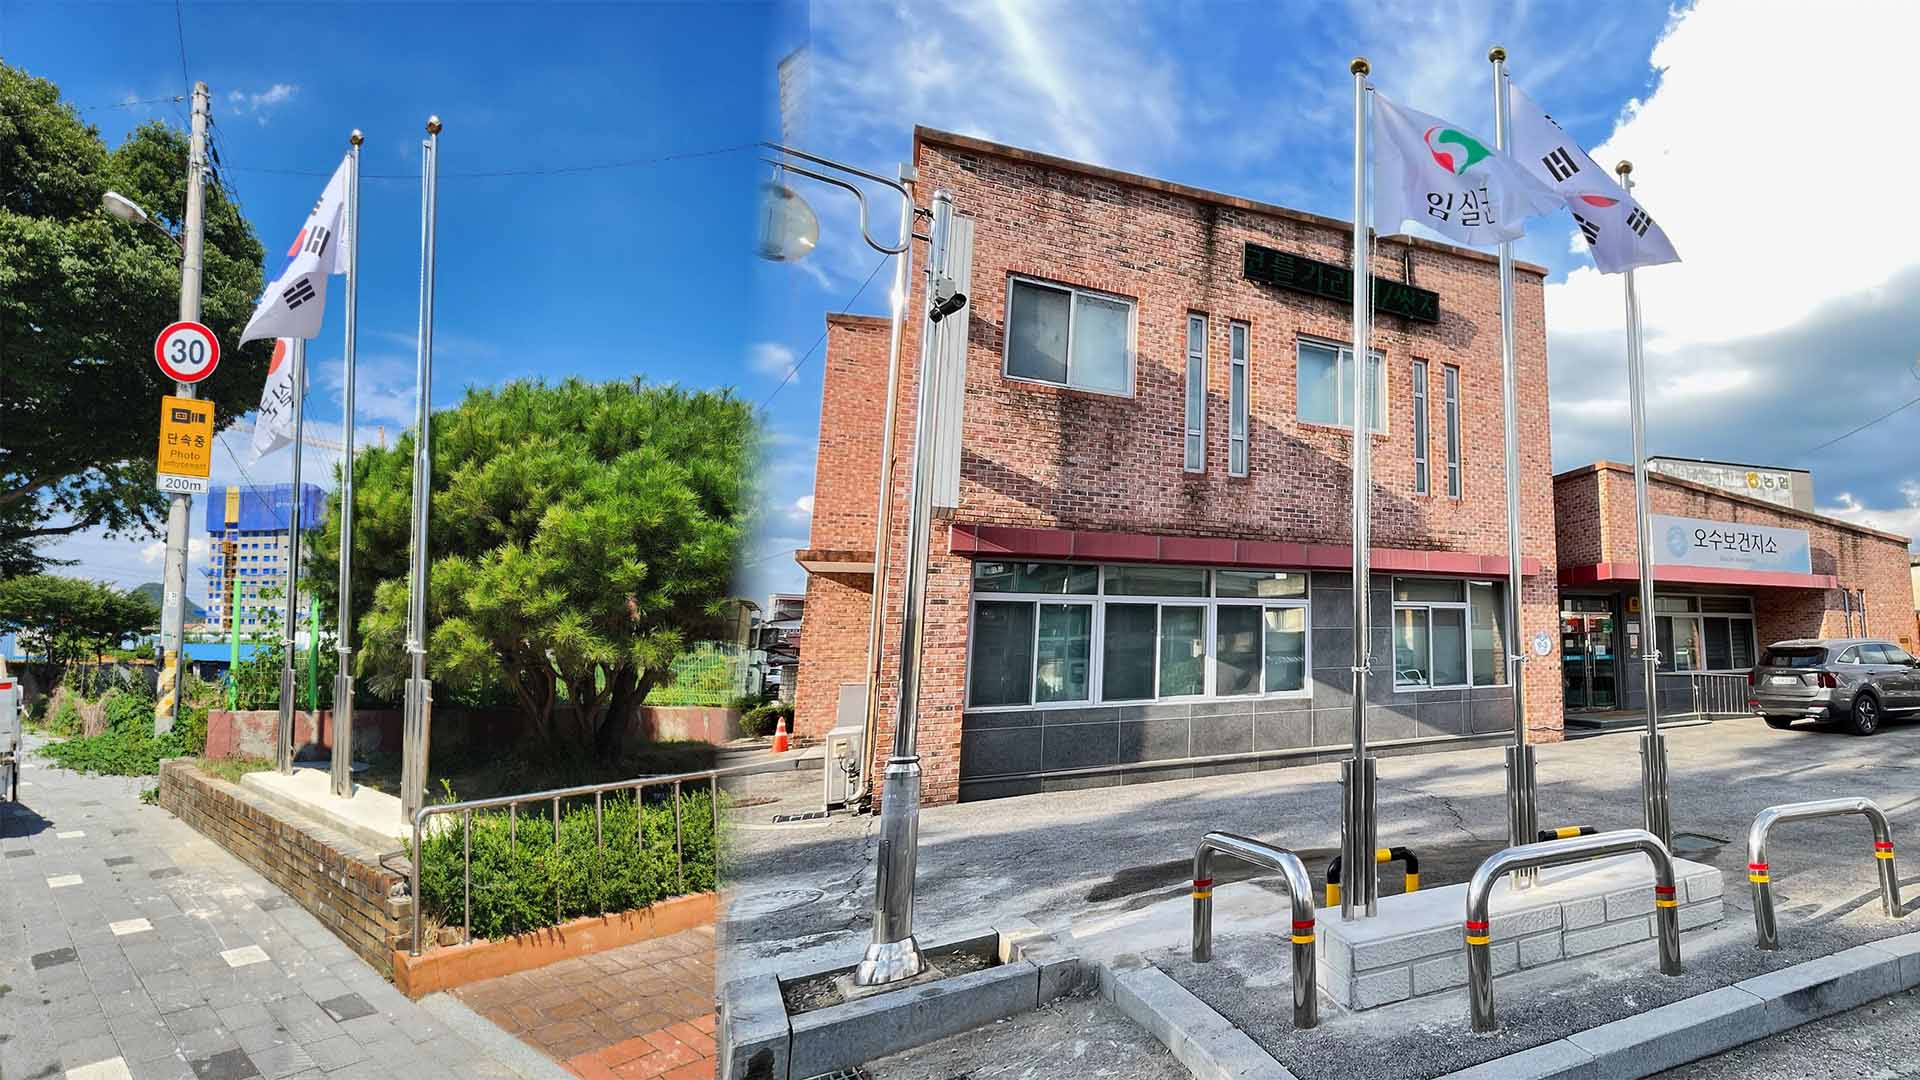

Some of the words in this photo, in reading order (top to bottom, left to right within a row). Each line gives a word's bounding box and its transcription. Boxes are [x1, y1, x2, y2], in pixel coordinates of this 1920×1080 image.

[171, 339, 205, 364] 30
[167, 432, 206, 448] 단속중
[170, 449, 201, 460] Photo
[165, 478, 201, 491] 200m
[1694, 528, 1777, 554] 오수보건지소
